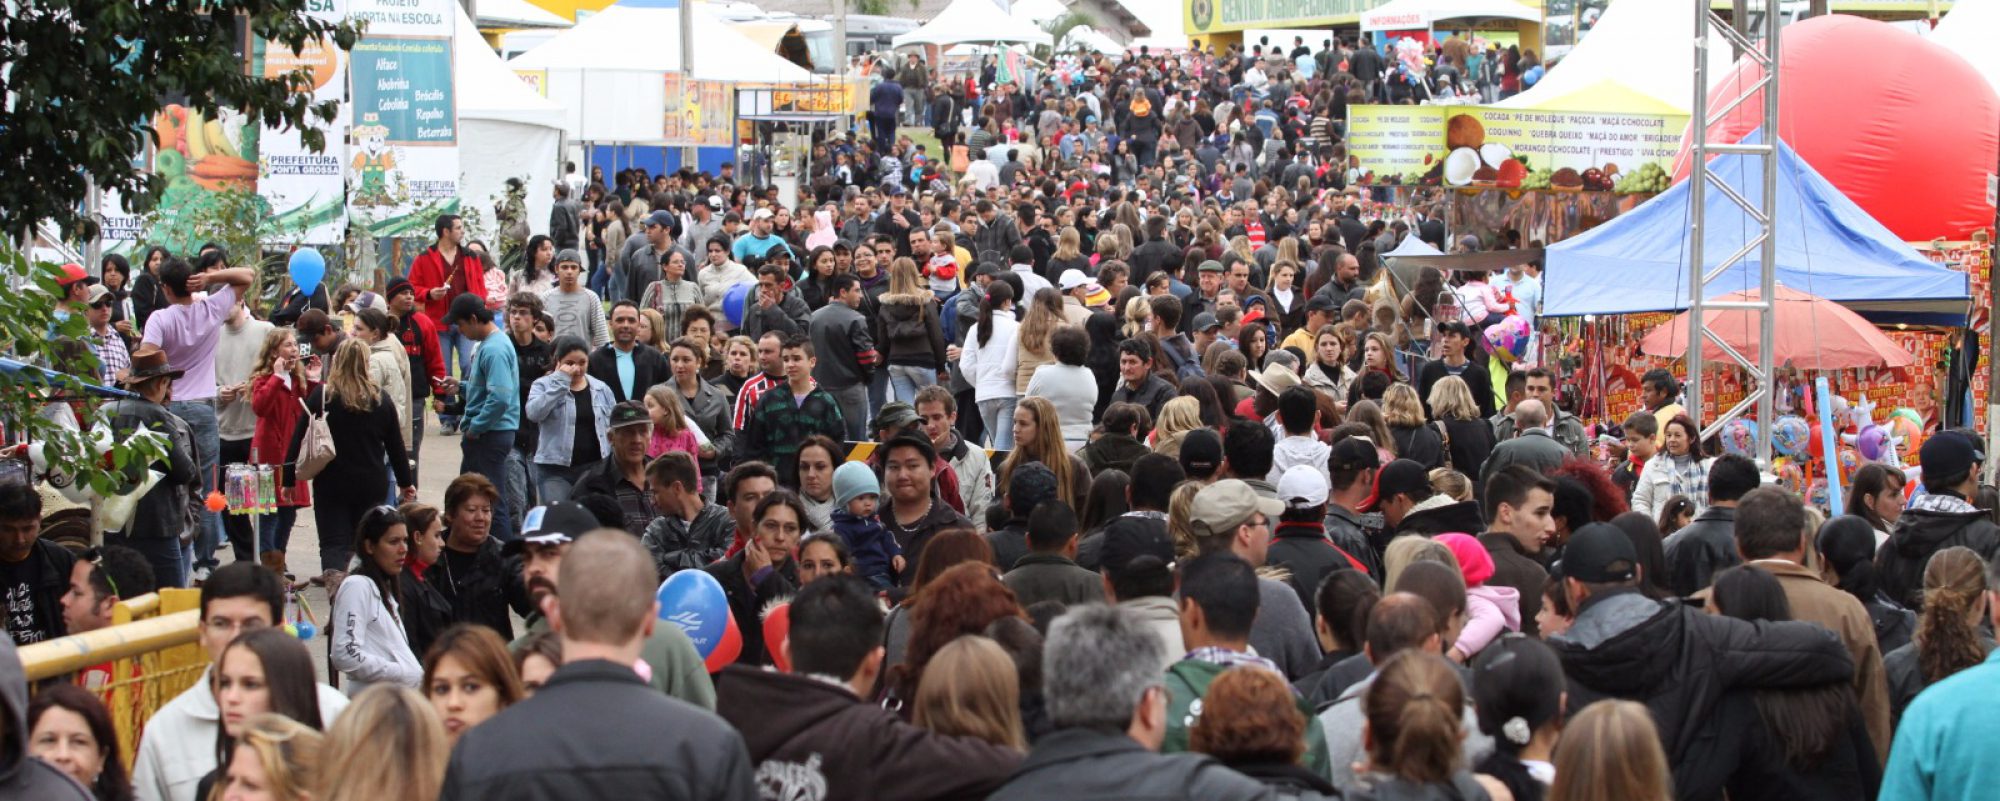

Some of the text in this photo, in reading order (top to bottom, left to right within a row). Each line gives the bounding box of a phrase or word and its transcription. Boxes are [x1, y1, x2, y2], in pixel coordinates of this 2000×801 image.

[402, 13, 442, 25] ESCOLA
[1369, 14, 1421, 26] INFORMAÇÕES
[375, 57, 398, 71] Alface
[1484, 112, 1510, 121] COCADA
[1524, 114, 1534, 122] DE
[1534, 114, 1565, 123] MOLEQUE
[417, 125, 452, 138] Beterraba
[1559, 130, 1583, 140] QUEIXO
[1608, 133, 1618, 141] DO
[1619, 133, 1638, 142] AMOR
[270, 155, 339, 165] PREFEITURA
[271, 165, 340, 175] PONTA GROSSA
[409, 180, 455, 189] PREFEITURA
